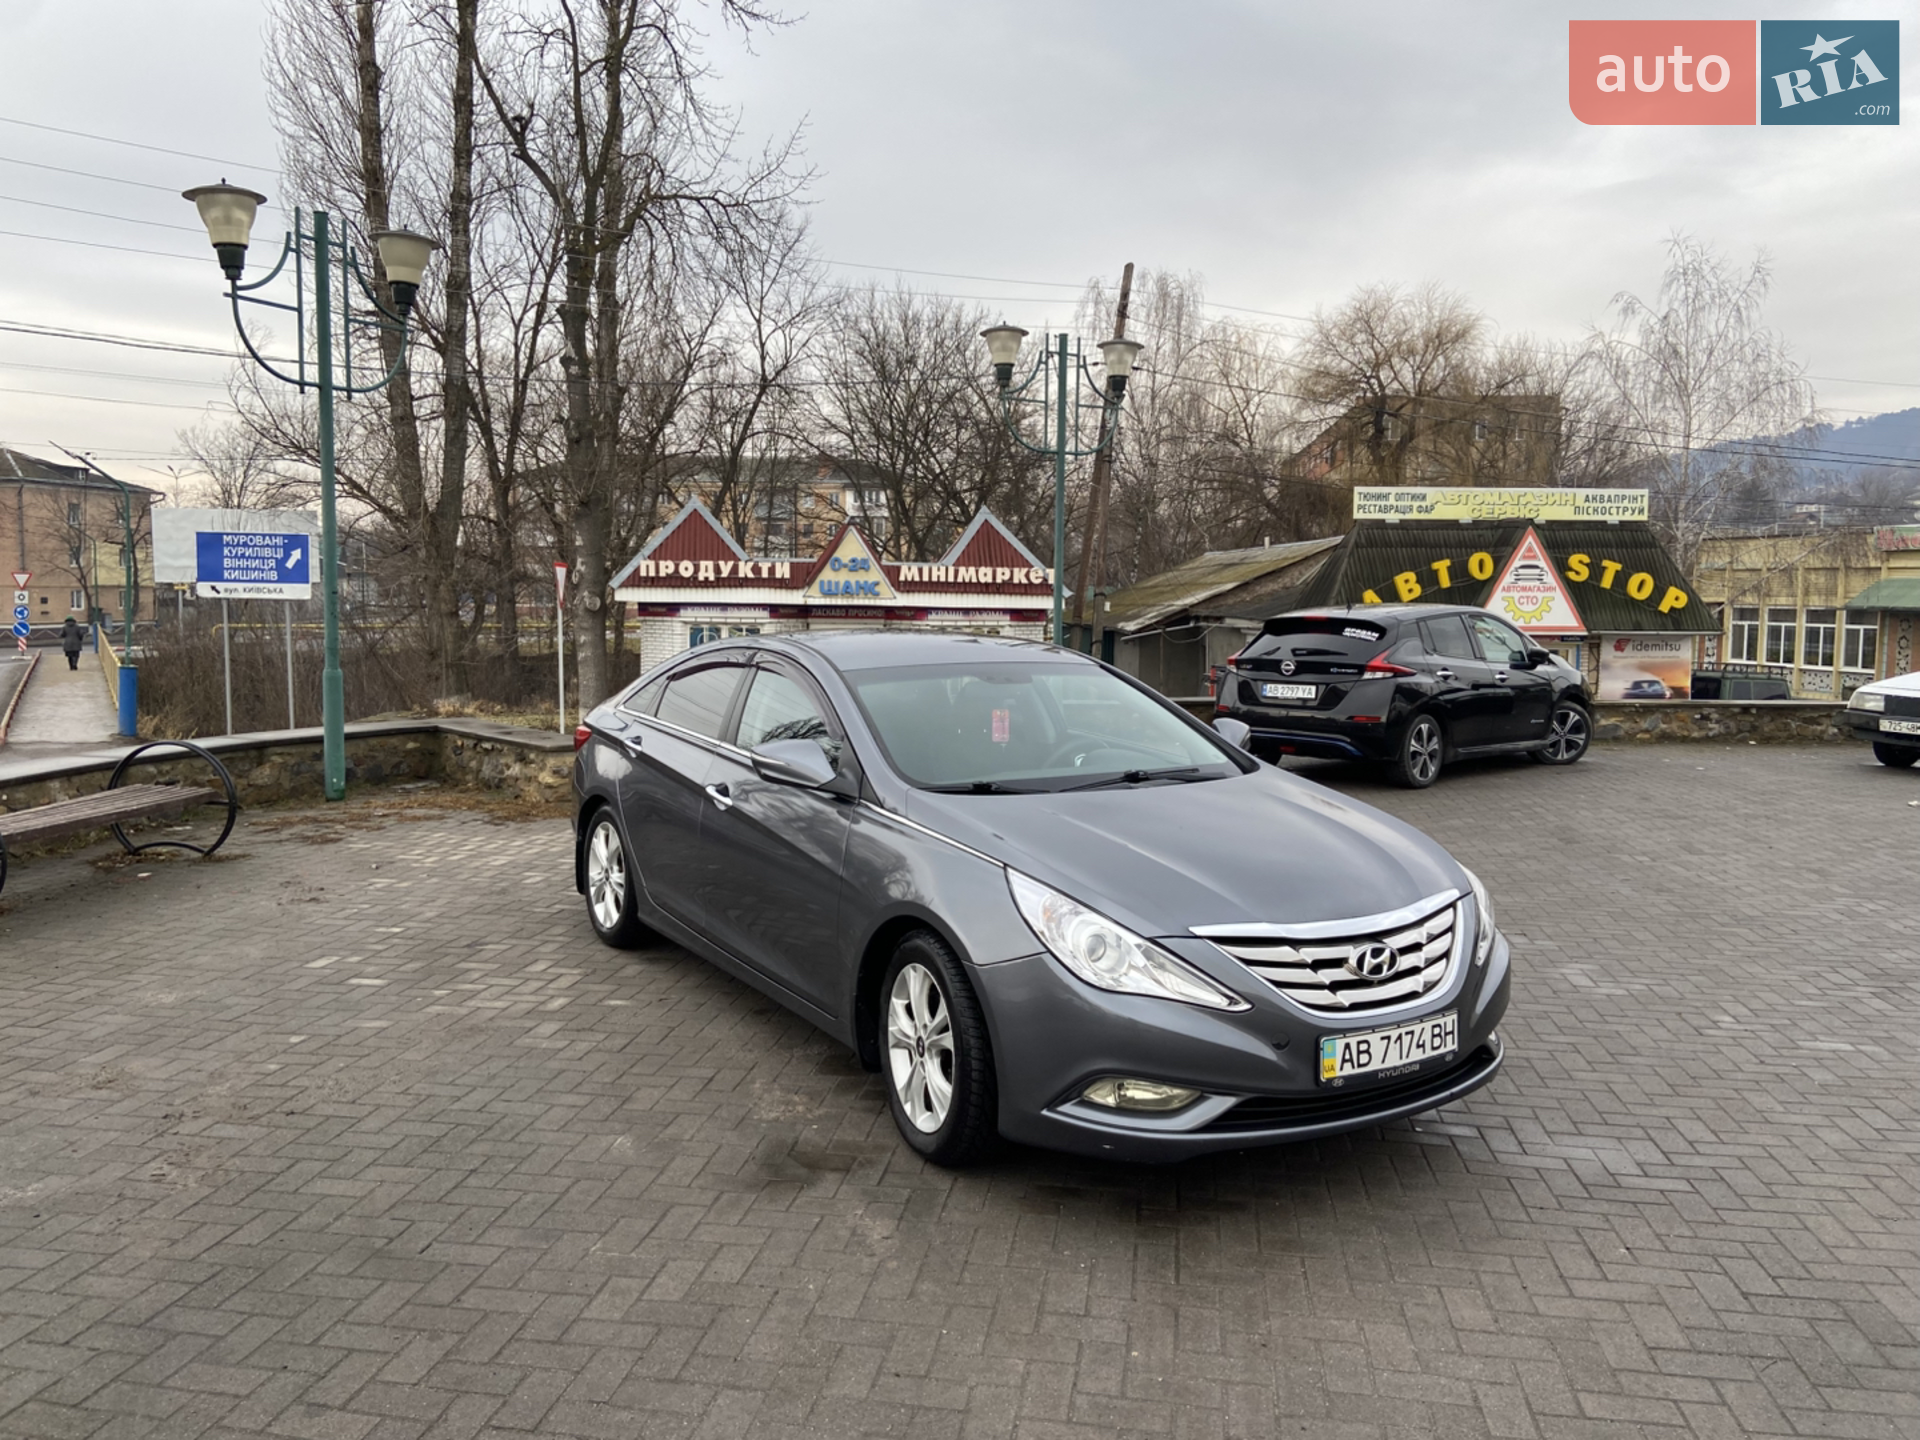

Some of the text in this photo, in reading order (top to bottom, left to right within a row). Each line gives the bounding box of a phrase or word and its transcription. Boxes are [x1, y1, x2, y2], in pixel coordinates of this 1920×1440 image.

[1357, 492, 1427, 502] ТЮНИНГ ОПТИКИ
[1431, 490, 1577, 507] АВТОМАГАЗИН
[1583, 494, 1646, 505] АКВАПРІНТ
[1356, 503, 1436, 516] РЕСТАВРАЦІЯ ФАР
[1467, 505, 1541, 520] СЕРВІС
[1573, 504, 1646, 516] ПІСКОСТРУЙ
[223, 535, 288, 546] МУРОВАНІ-
[223, 547, 284, 559] КУРИЛІВЦІ
[223, 559, 276, 570] ВІННИЦЯ
[639, 559, 791, 581] ПРОДУКТИ
[829, 557, 871, 572] 0-24
[223, 570, 278, 581] КИШИНІВ
[818, 579, 881, 596] ШАНС
[1501, 585, 1557, 594] АВТОМАГАЗИН
[1564, 553, 1689, 614] STOP
[243, 586, 284, 594] КИЇВСЬКА
[1517, 595, 1540, 606] СТО
[1631, 640, 1682, 652] idemitsu
[1339, 1018, 1456, 1072] AB 7174 BH
[1323, 1064, 1336, 1074] UA
[1378, 1064, 1420, 1079] HYUNDAI
